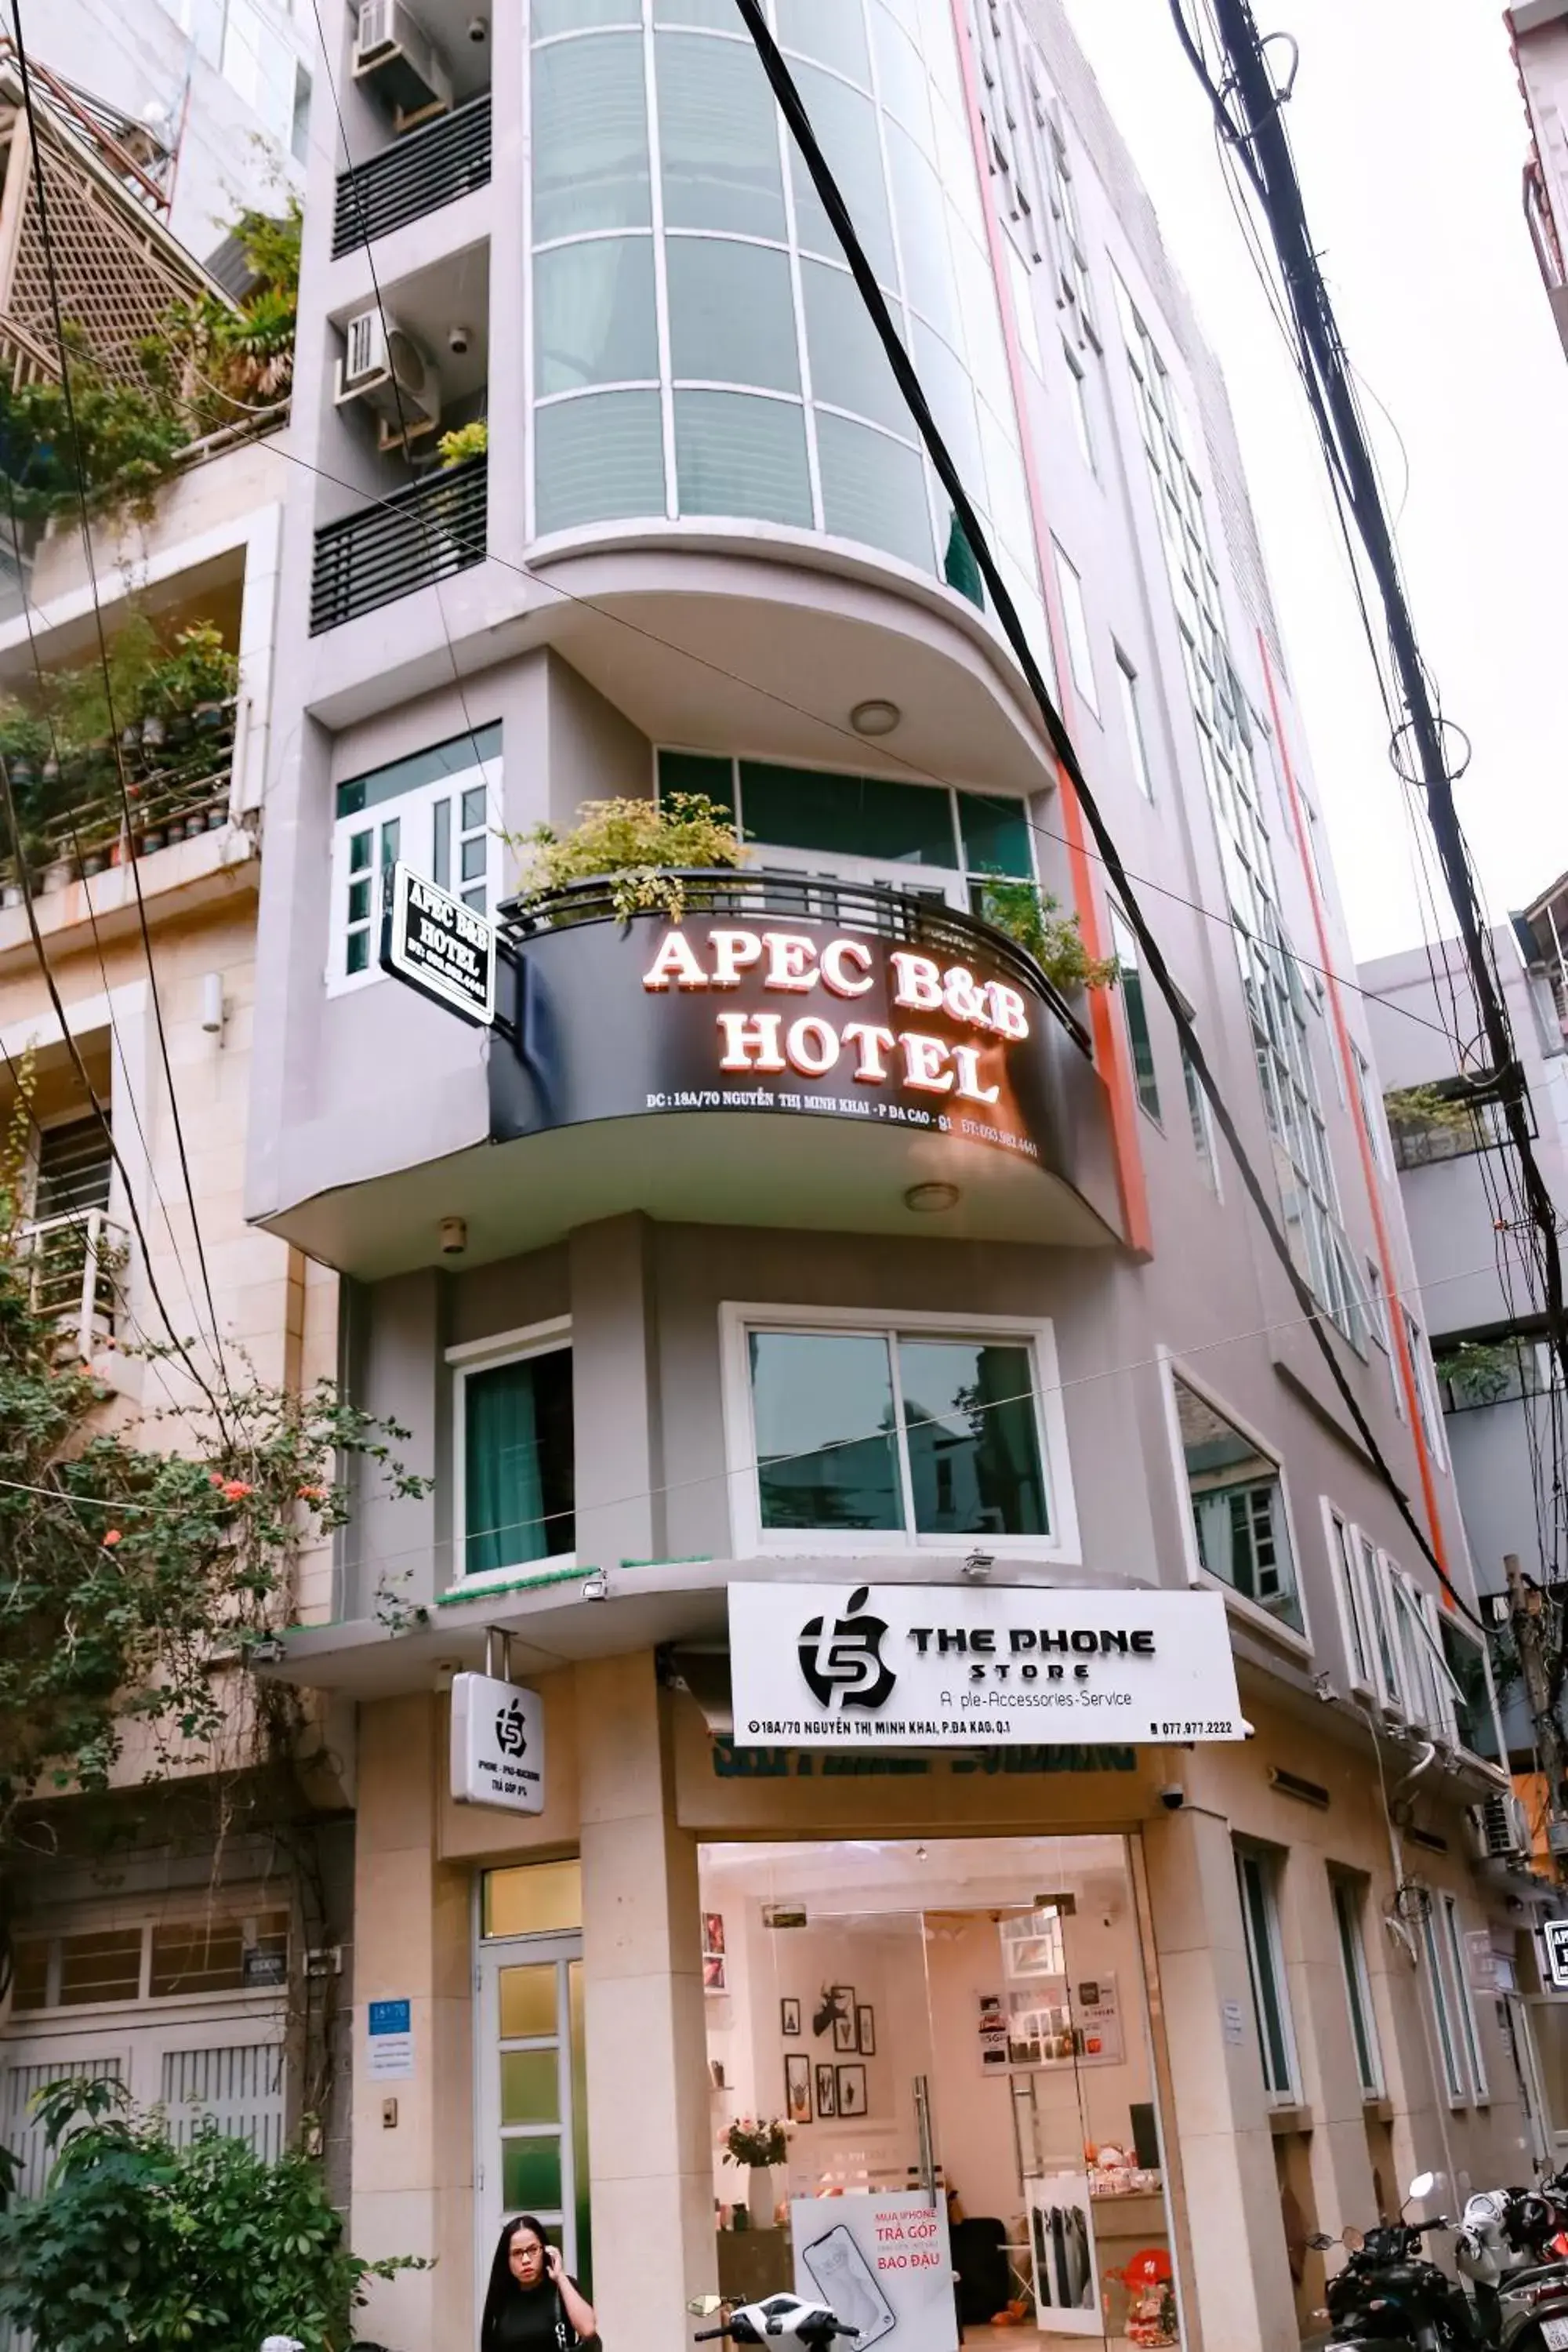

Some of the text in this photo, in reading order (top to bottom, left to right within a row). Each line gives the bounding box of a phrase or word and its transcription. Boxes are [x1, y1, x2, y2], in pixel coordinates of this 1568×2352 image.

[409, 883, 488, 952] APEC B&B
[419, 917, 481, 978] HOTEL
[642, 930, 1030, 1041] APEC B&B
[717, 1012, 1000, 1105] HOTEL
[779, 1093, 801, 1111] THỊ
[804, 1095, 837, 1111] MINH
[839, 1098, 870, 1115] KHAI
[907, 1108, 931, 1125] CAO
[909, 1628, 1156, 1653] THE PHONE
[970, 1664, 1089, 1679] STORE
[762, 1721, 800, 1735] 18A/70
[855, 1721, 873, 1737] THỊ
[875, 1721, 906, 1735] MINH
[1162, 1721, 1232, 1735] 077.977.2222
[875, 2212, 898, 2221] MUA
[876, 2221, 937, 2241] TRẢ GÓP
[877, 2256, 907, 2270] BAO
